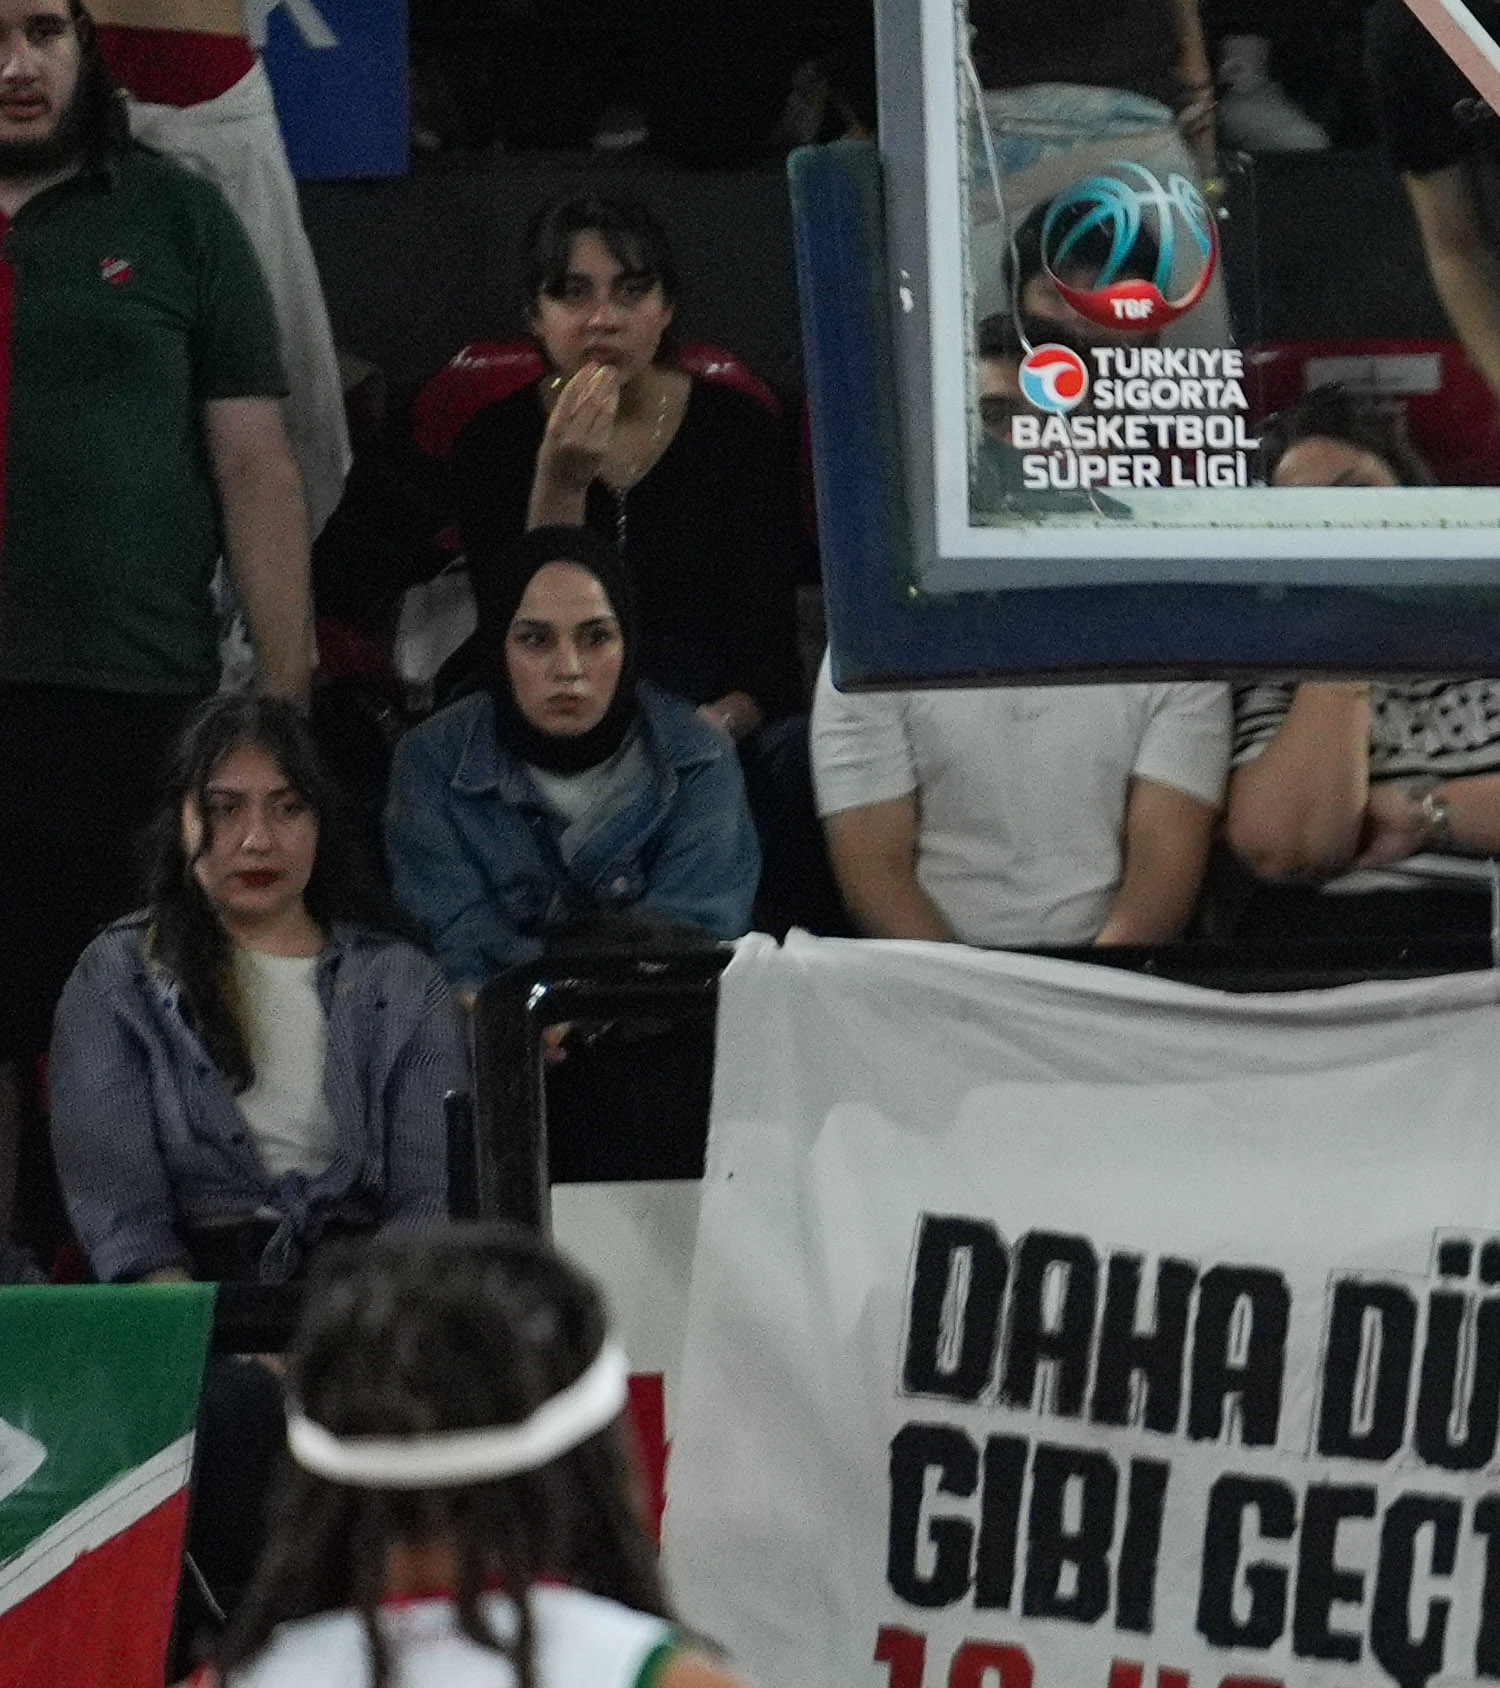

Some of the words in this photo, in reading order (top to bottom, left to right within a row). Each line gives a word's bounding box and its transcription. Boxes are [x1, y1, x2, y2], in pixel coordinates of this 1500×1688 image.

[1110, 299, 1153, 320] TBF
[1011, 414, 1258, 450] BASKETBOL
[1022, 448, 1163, 490] SÜPER
[1171, 448, 1248, 488] LİGİ
[901, 1212, 1292, 1447] DAHA
